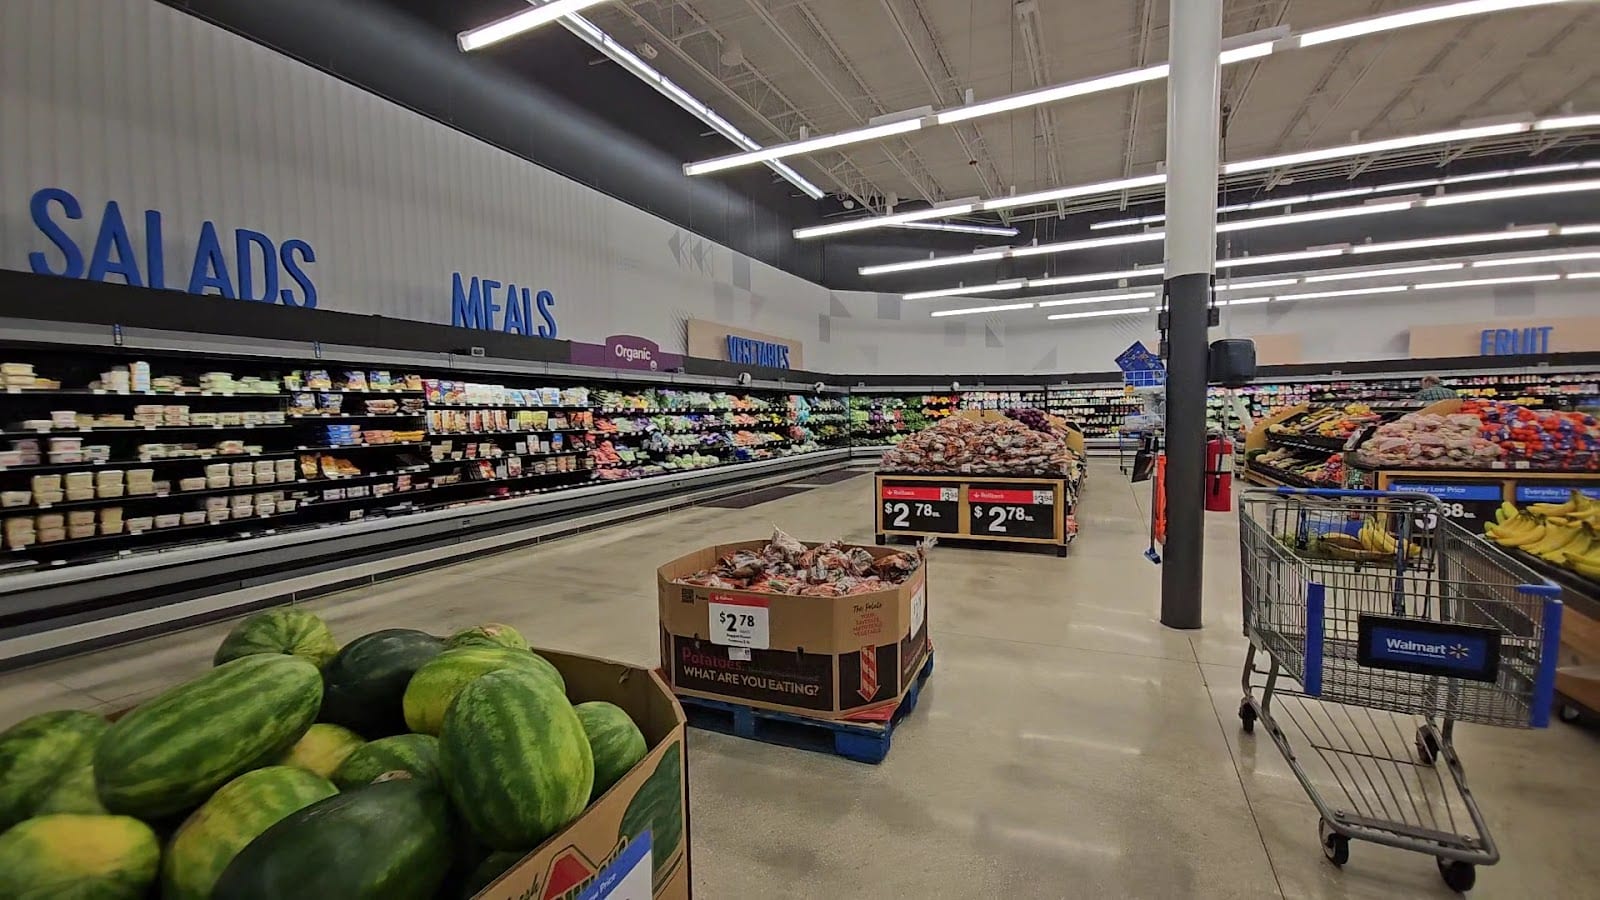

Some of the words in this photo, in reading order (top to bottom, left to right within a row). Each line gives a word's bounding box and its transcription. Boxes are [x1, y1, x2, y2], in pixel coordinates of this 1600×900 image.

[29, 188, 319, 310] SALADS
[452, 272, 557, 340] MEALS
[615, 343, 651, 362] Organic
[727, 335, 790, 369] VEGETABLES
[1480, 327, 1553, 356] FRUIT
[1447, 486, 1466, 494] Price
[1524, 488, 1559, 496] Everyday
[1386, 637, 1446, 655] Walmart
[683, 665, 716, 681] WHAT
[717, 672, 740, 685] ARE
[741, 675, 767, 689] YOU
[768, 679, 820, 697] EATING?
